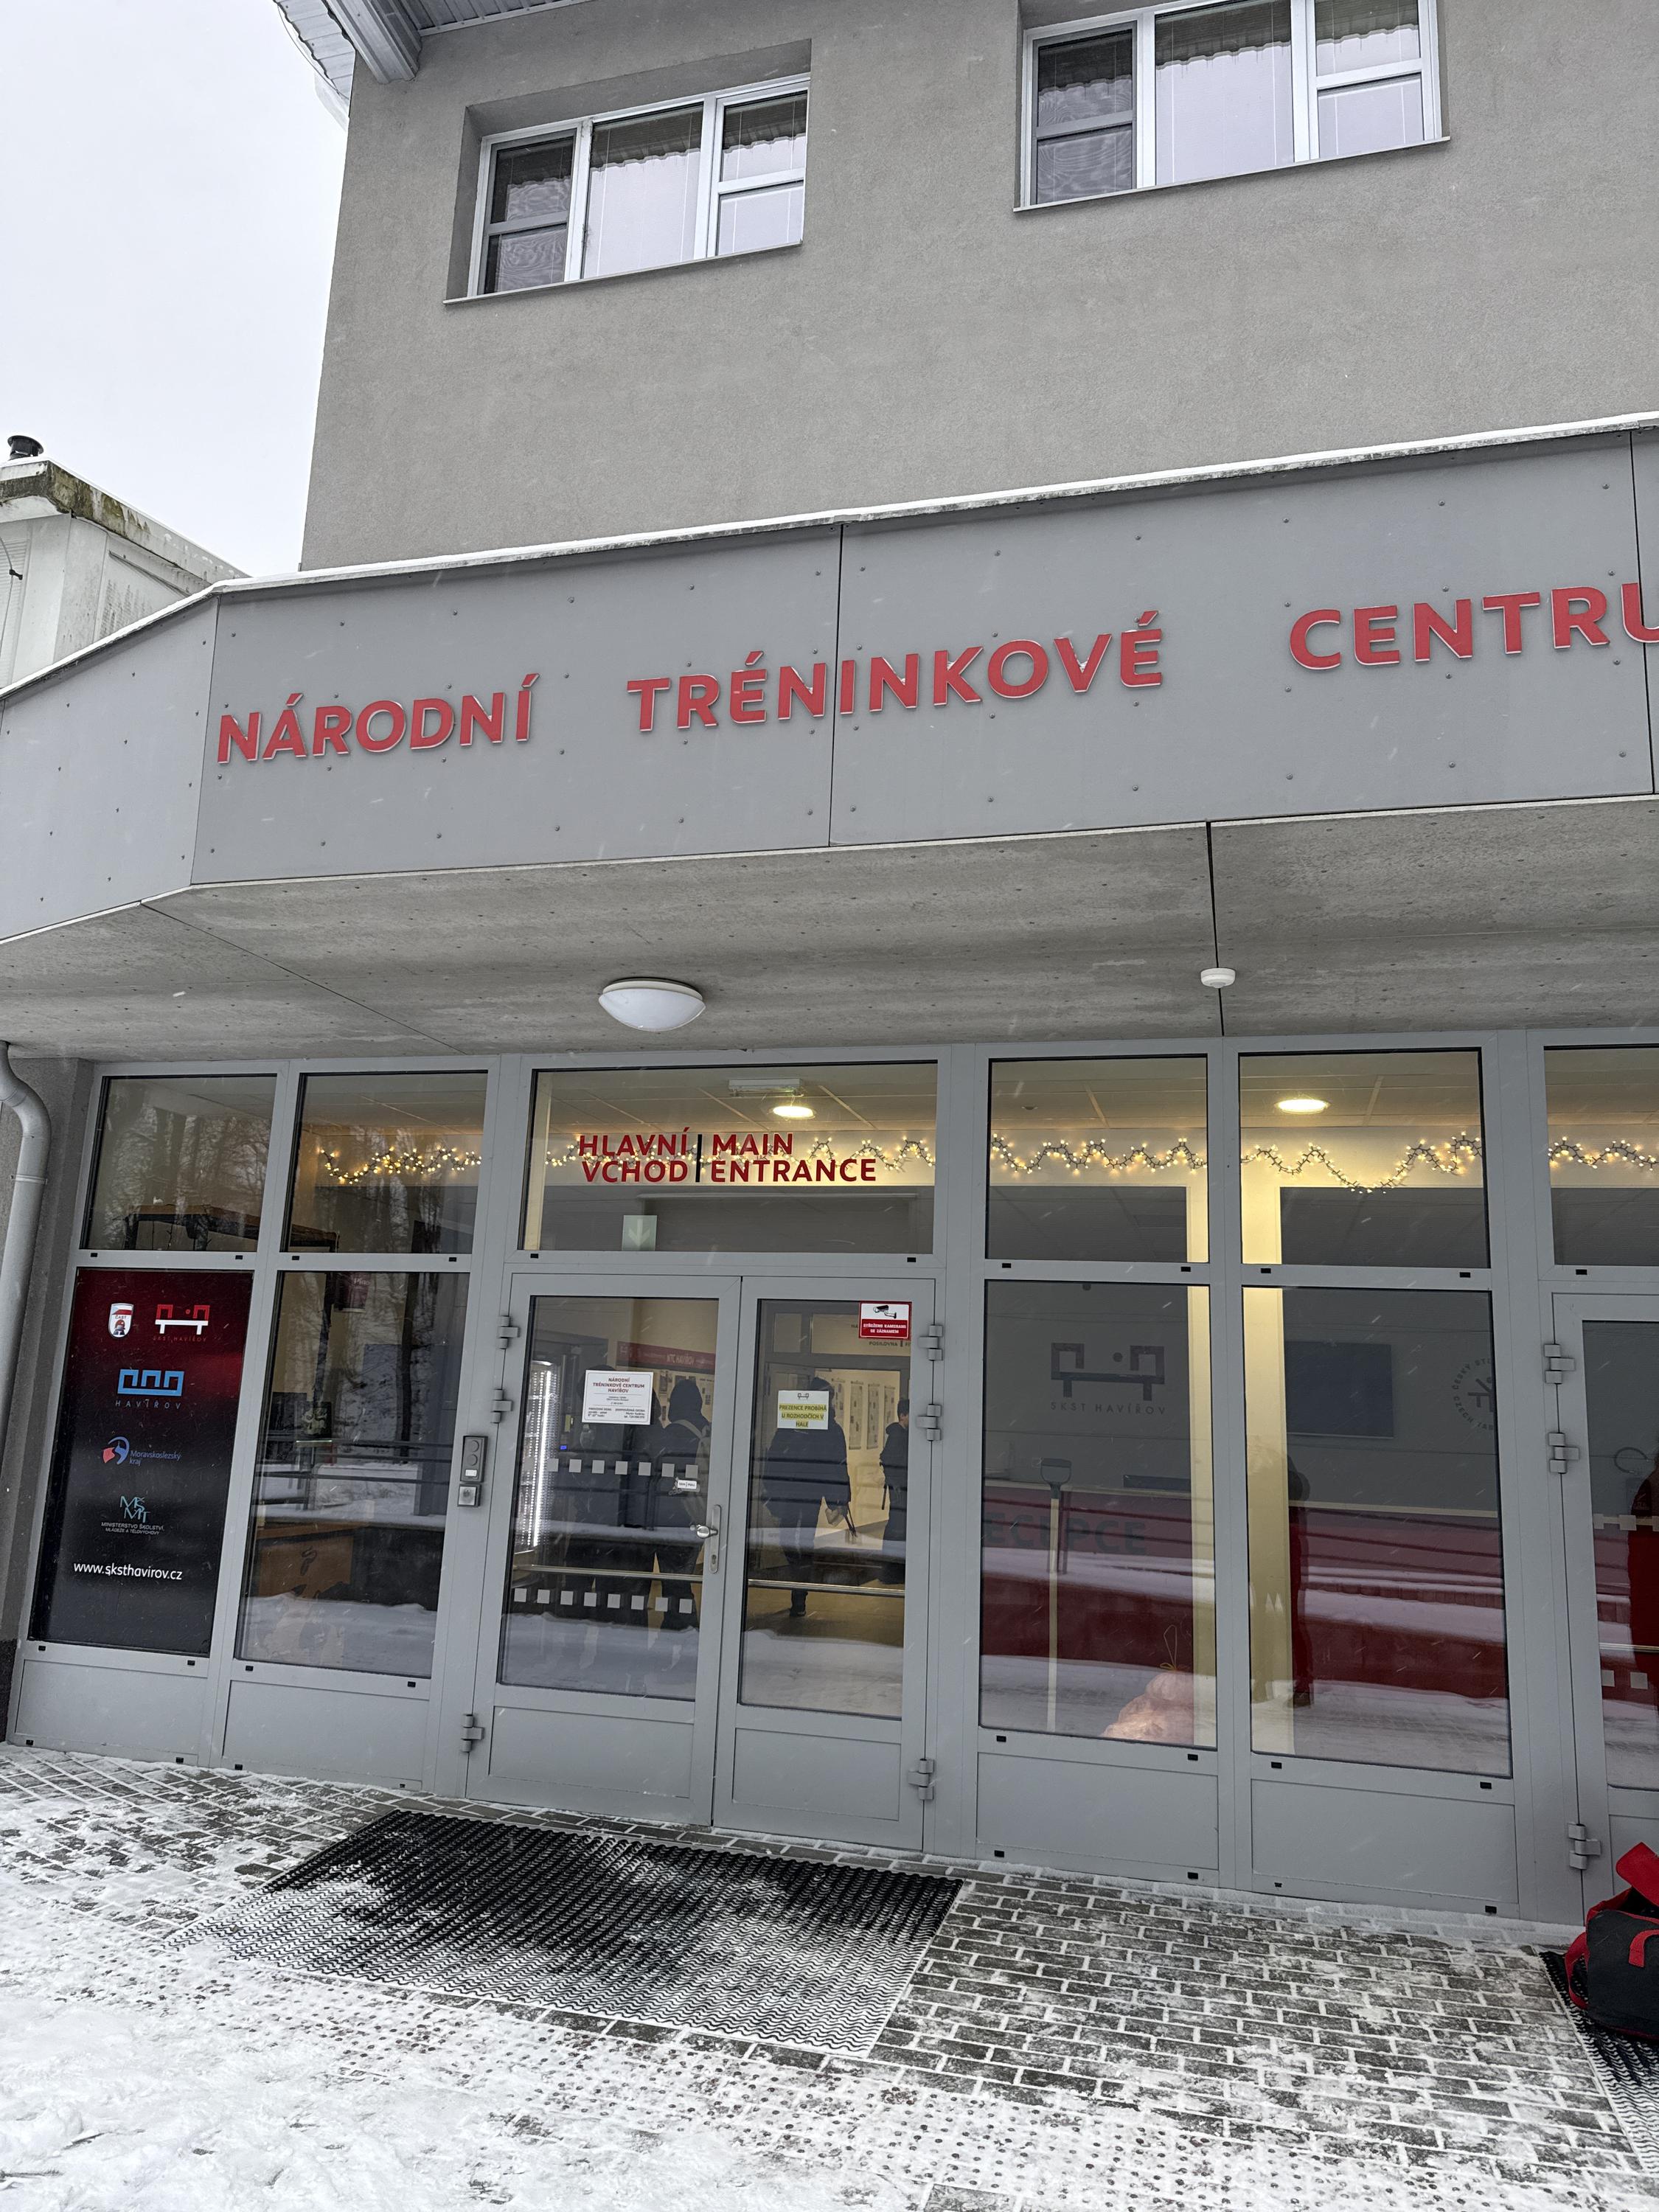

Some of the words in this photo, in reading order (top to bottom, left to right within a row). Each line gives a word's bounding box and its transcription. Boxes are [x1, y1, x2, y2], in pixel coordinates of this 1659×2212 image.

[218, 673, 540, 764] NÁRODNÍ
[627, 611, 1163, 732] TRÉNINKOVÉ
[578, 1127, 690, 1157] HLAVNÍ
[712, 1133, 793, 1156] MAIN
[582, 1160, 688, 1183] VCHOD
[711, 1158, 877, 1183] ENTRANCE
[115, 1399, 181, 1409] HAVÍŘOV
[1051, 1402, 1086, 1411] SKST
[1095, 1403, 1165, 1415] HAVÍŘOV
[73, 1562, 183, 1580] www.sksthavirov.cz
